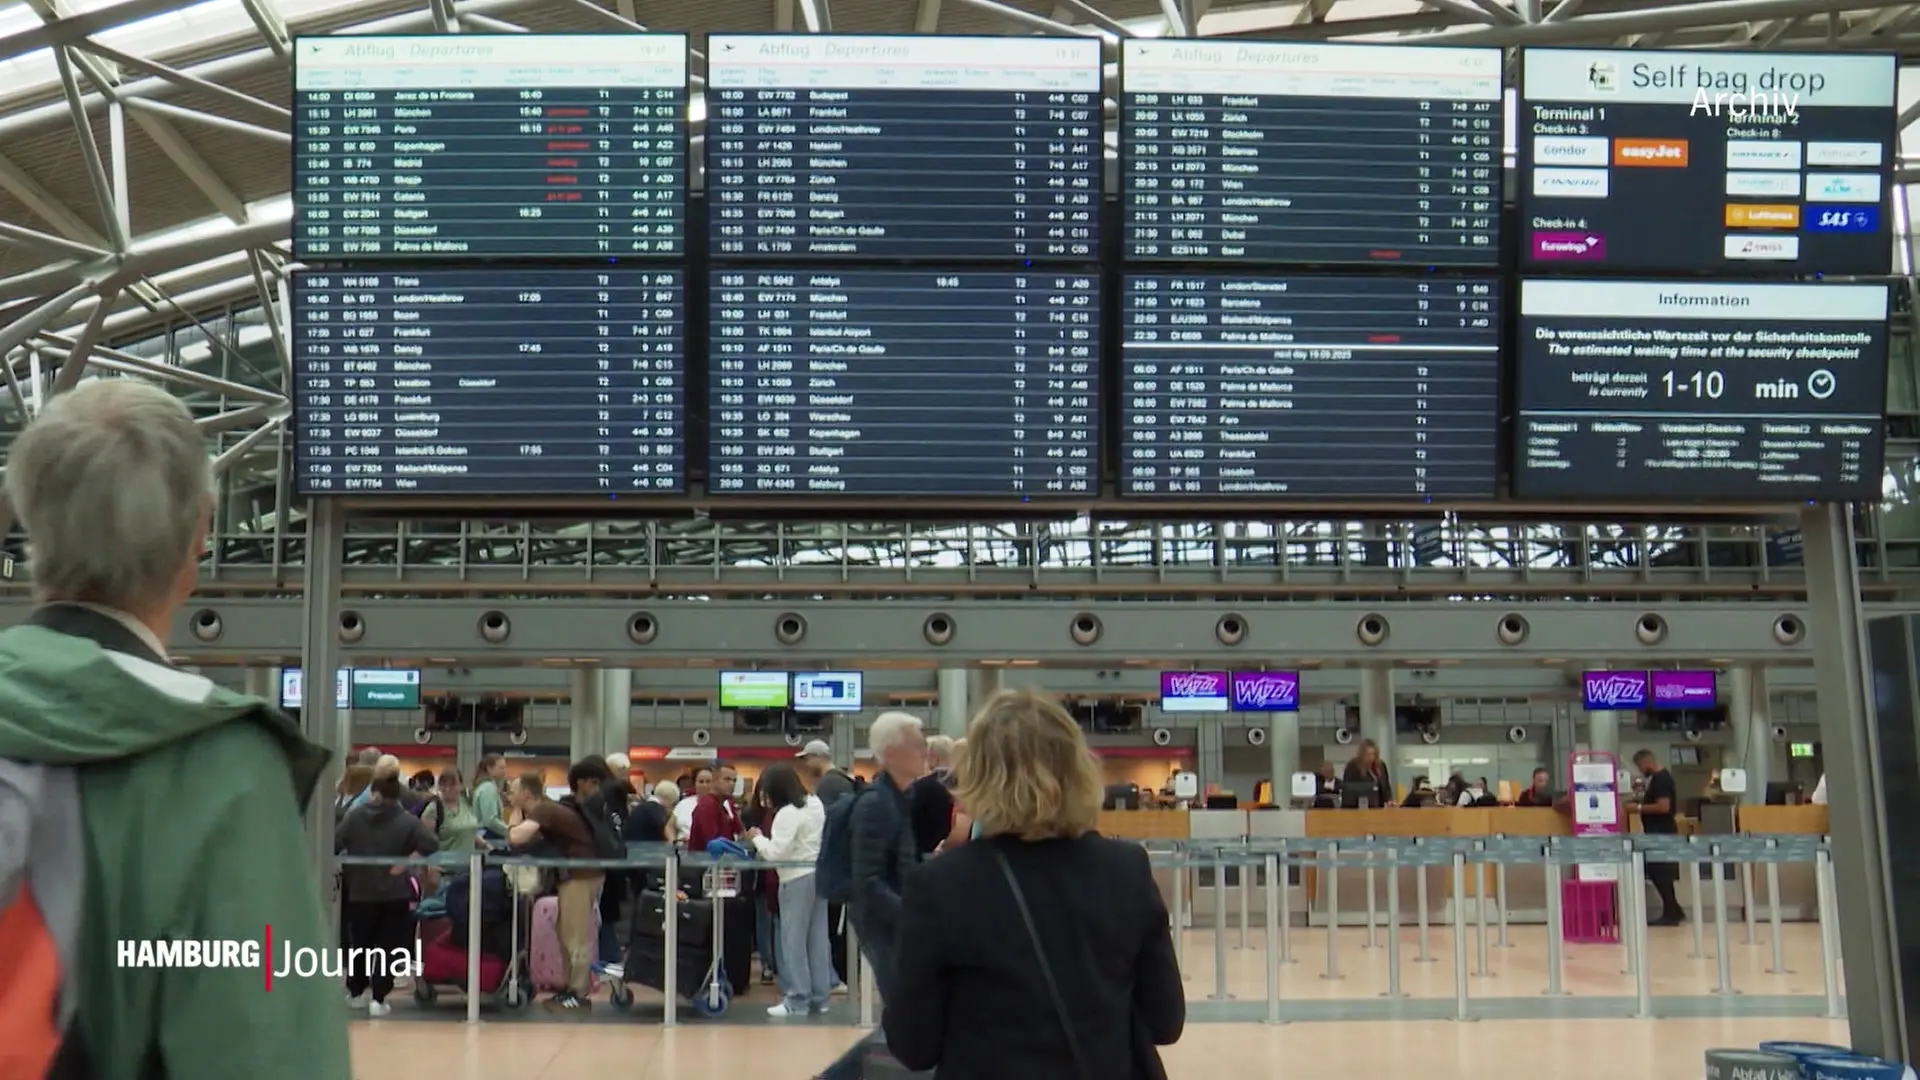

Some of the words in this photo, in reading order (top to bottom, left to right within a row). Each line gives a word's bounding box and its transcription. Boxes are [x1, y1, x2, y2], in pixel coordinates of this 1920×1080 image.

[345, 44, 395, 59] Abflug
[409, 45, 494, 57] Departures
[758, 43, 810, 58] Abflug
[825, 44, 910, 57] Departures
[1172, 48, 1222, 63] Abflug
[1236, 50, 1320, 64] Departures
[1632, 64, 1685, 88] Self
[1697, 66, 1747, 95] bag
[1759, 67, 1826, 97] drop
[598, 89, 610, 99] T1
[1014, 92, 1026, 101] T1
[598, 106, 610, 117] T2
[1419, 101, 1431, 110] T2
[1474, 103, 1491, 111] A17
[1533, 105, 1594, 121] Terminal
[1598, 107, 1606, 121] 1
[1727, 110, 1787, 125] Terminal
[1790, 111, 1800, 126] 2
[394, 124, 417, 134] Porto
[598, 122, 609, 133] T1
[1533, 122, 1578, 134] Check-in
[1579, 124, 1590, 135] 3:
[1726, 127, 1770, 139] Check-in
[598, 140, 610, 150] T2
[1621, 144, 1682, 159] easyJet
[656, 190, 674, 200] A17
[598, 207, 609, 217] T1
[1747, 208, 1794, 221] Lufthansa
[1532, 216, 1576, 229] Check-in
[1577, 218, 1588, 230] 4:
[1818, 211, 1852, 228] SAS
[1418, 234, 1429, 243] T1
[1541, 241, 1588, 254] Eurowings
[1015, 277, 1027, 288] T2
[1418, 284, 1429, 293] T2
[598, 291, 609, 302] T2
[1015, 295, 1026, 304] T1
[1658, 293, 1751, 308] Information
[597, 309, 609, 318] T1
[1418, 317, 1428, 326] T1
[655, 325, 673, 336] A17
[1014, 329, 1026, 338] T1
[1535, 327, 1556, 340] Die
[1557, 328, 1652, 342] voraussichtliche
[1652, 330, 1709, 342] Wartezeit
[1711, 333, 1730, 342] vor
[1733, 331, 1754, 343] der
[1755, 331, 1872, 344] Sicherheitskontrolle
[598, 343, 610, 352] T2
[1548, 343, 1571, 355] The
[1572, 344, 1632, 356] estimated
[1634, 345, 1679, 359] waiting
[1680, 345, 1709, 358] time
[1710, 347, 1724, 358] at
[1726, 346, 1745, 358] the
[1747, 346, 1794, 361] security
[1795, 346, 1860, 361] checkpoint
[1417, 367, 1428, 376] T2
[1571, 371, 1610, 384] beträgt
[1611, 373, 1648, 384] derzeit
[1014, 379, 1026, 389] T2
[1417, 383, 1427, 392] T1
[1662, 370, 1724, 399] 1-10
[1755, 378, 1799, 399] min
[1588, 385, 1598, 397] is
[1599, 386, 1648, 399] currently
[1219, 415, 1240, 425] Faro
[1416, 416, 1427, 425] T1
[598, 427, 609, 436] T1
[1415, 450, 1427, 459] T2
